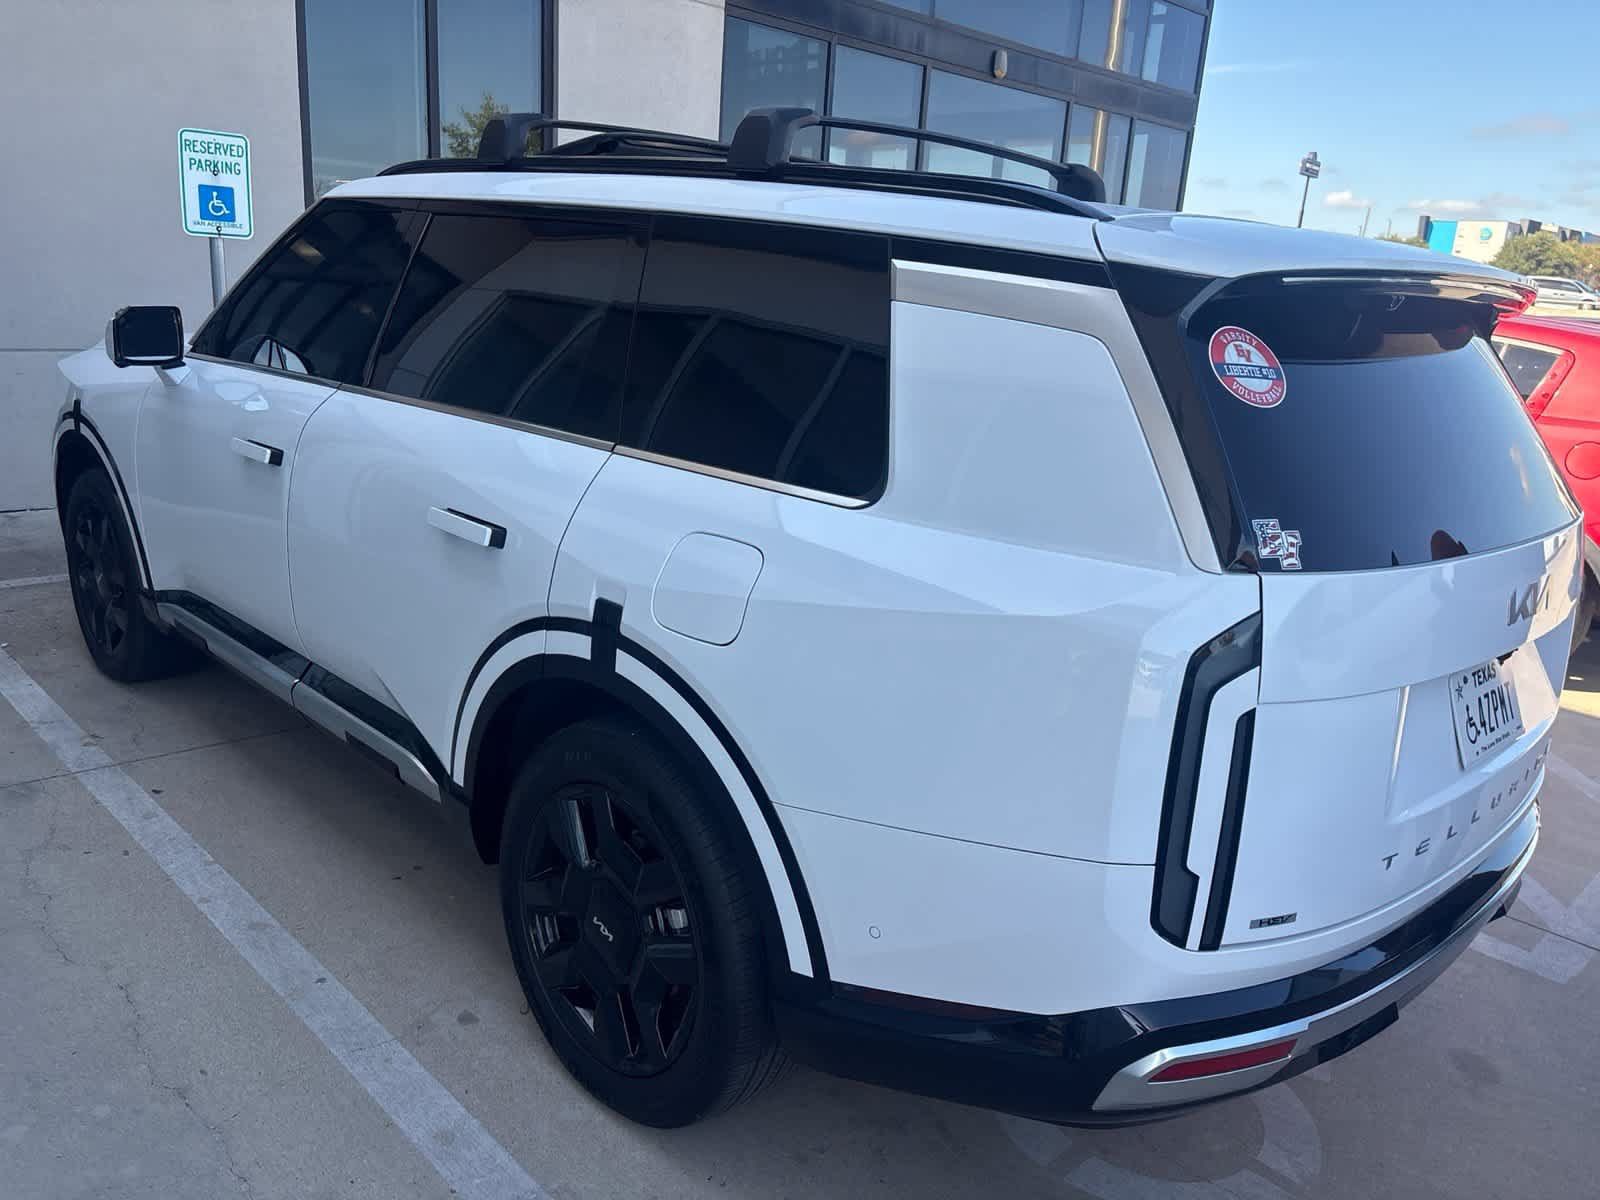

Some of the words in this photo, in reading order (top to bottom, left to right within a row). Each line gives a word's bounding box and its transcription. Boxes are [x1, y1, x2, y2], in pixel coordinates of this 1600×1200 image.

[184, 139, 244, 158] RESERVED
[189, 157, 241, 175] PARKING
[1232, 381, 1282, 403] VOLLEYBALL
[1472, 662, 1497, 688] TEXAS
